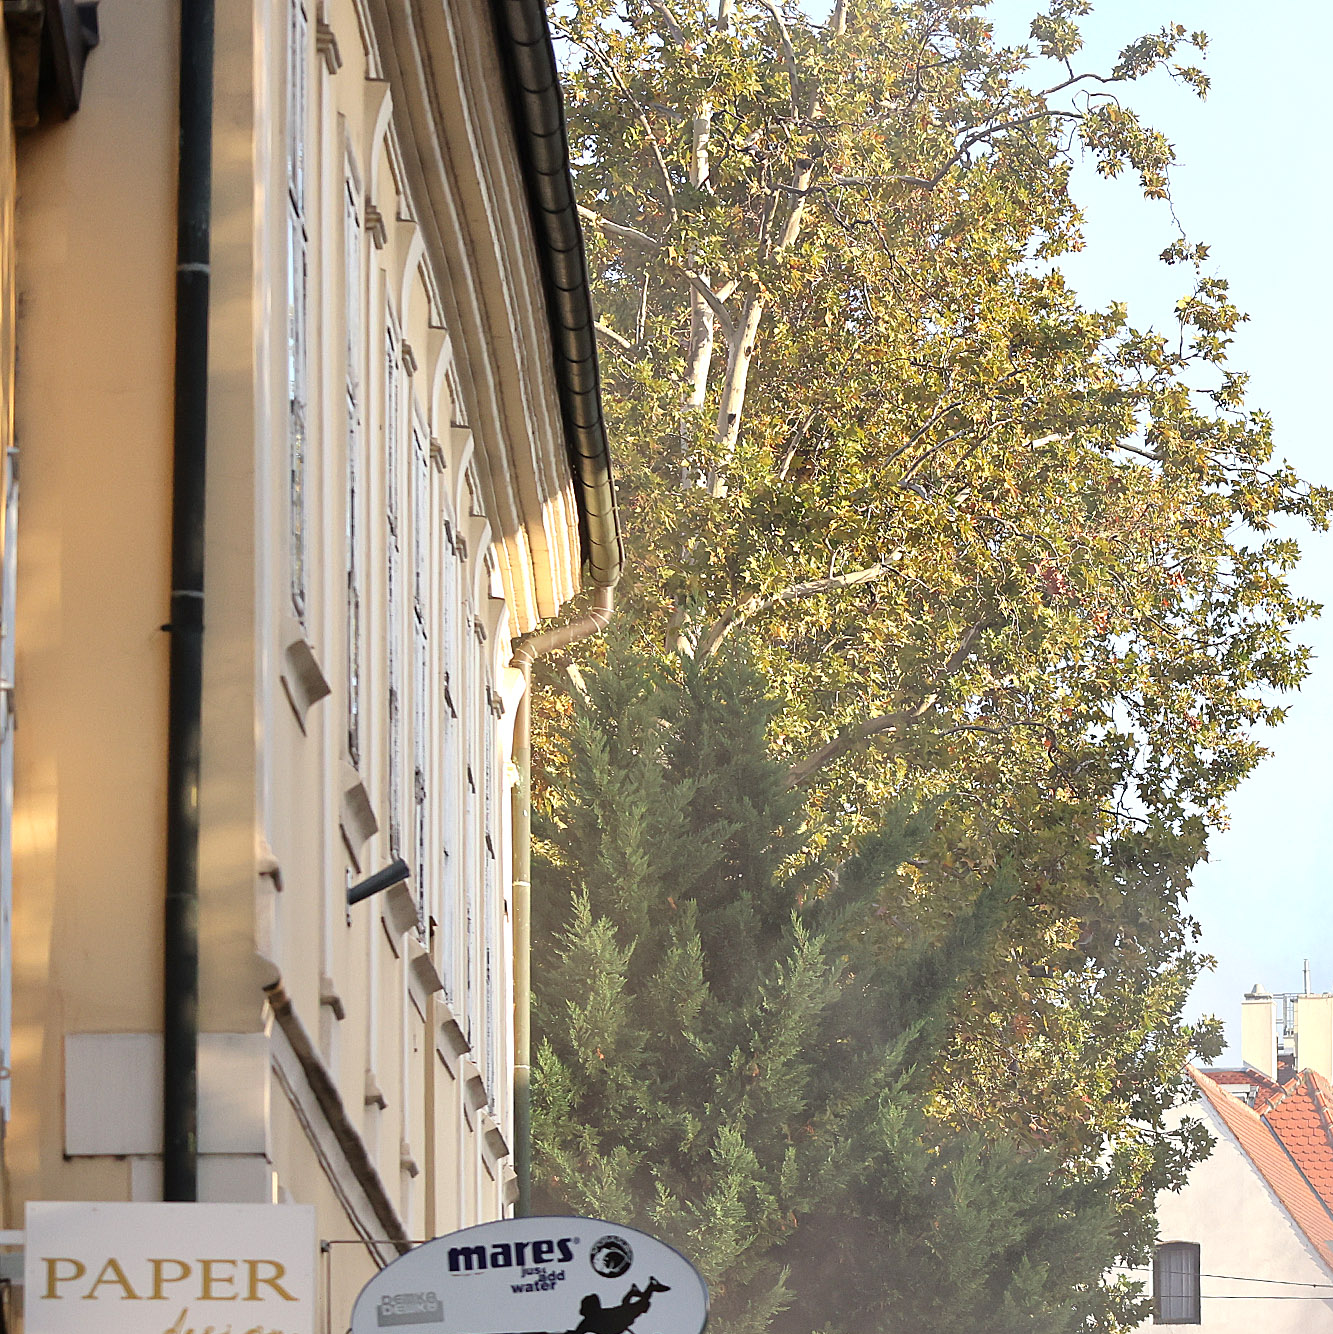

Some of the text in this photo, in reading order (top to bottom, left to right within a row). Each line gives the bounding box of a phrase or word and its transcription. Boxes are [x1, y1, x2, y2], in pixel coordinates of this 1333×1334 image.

[448, 1238, 573, 1272] mares
[40, 1257, 300, 1302] PAPER
[511, 1280, 557, 1293] water
[538, 1270, 566, 1282] add
